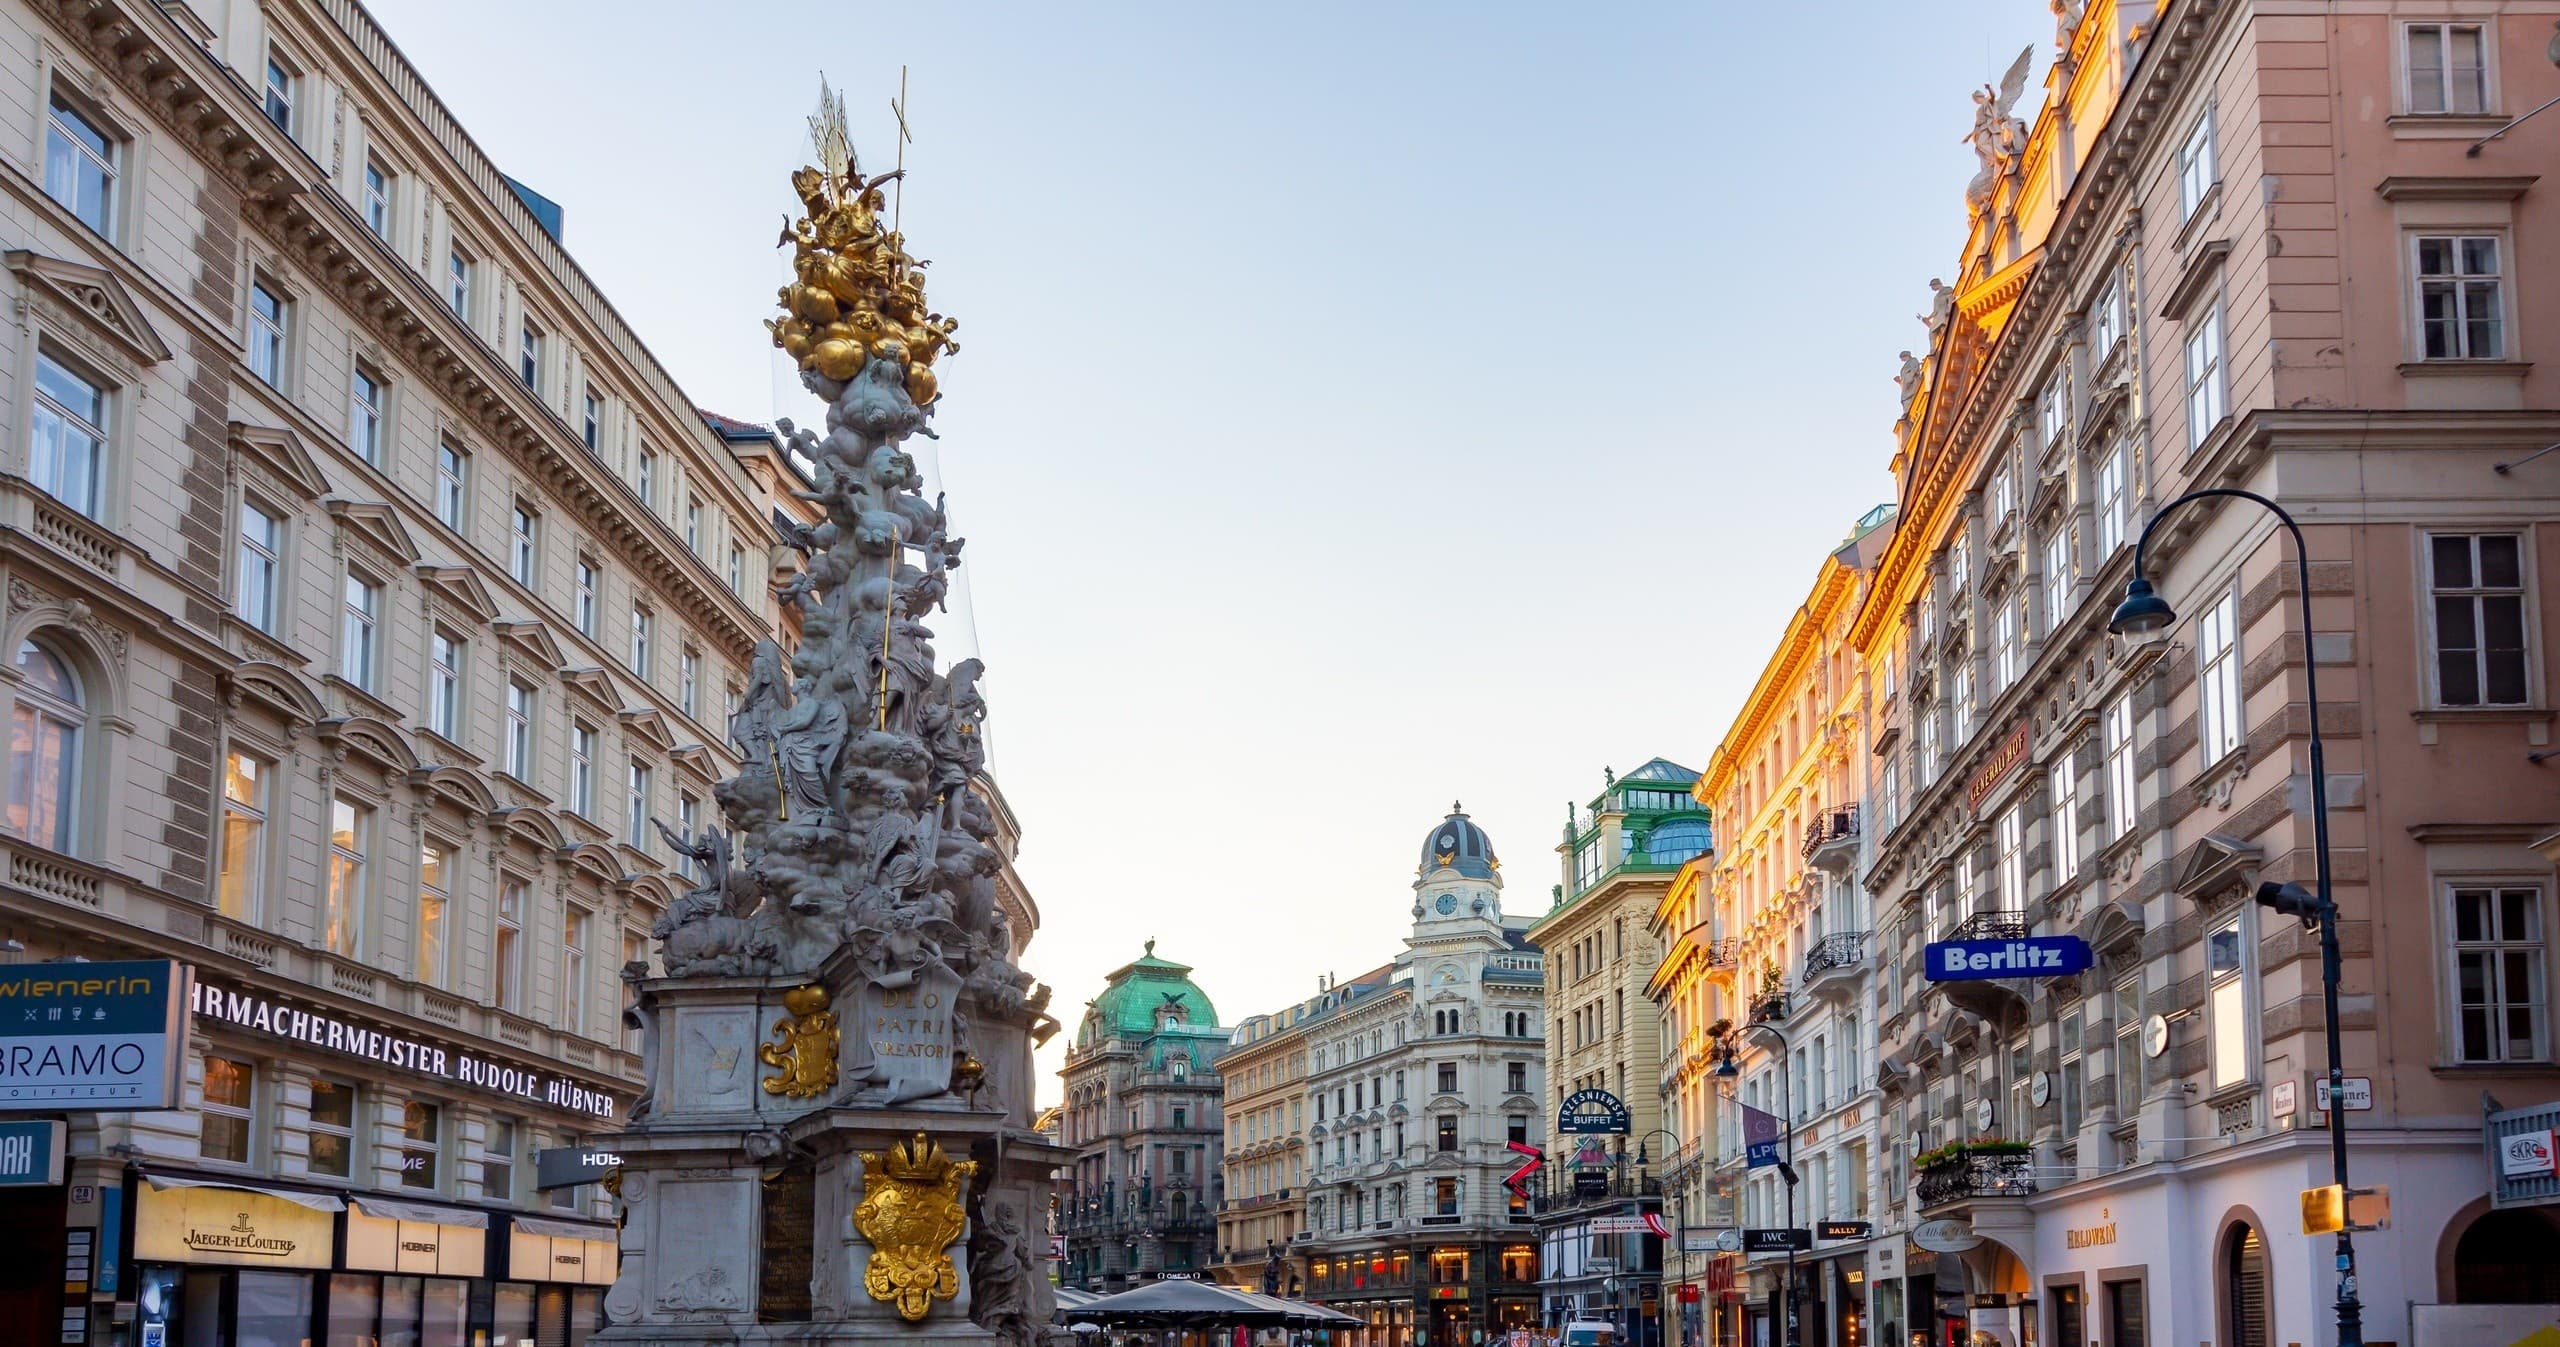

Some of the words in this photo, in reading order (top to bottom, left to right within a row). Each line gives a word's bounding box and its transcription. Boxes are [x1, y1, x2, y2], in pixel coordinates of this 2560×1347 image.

[1970, 749, 2006, 801] GENERALI
[2007, 731, 2025, 763] HOF
[1944, 942, 2063, 971] Berlitz
[0, 976, 151, 998] wienerin
[875, 1016, 944, 1034] PATRI
[0, 1043, 145, 1077] RAMO
[459, 1056, 537, 1097] RUDOLF
[547, 1078, 614, 1118] HÜBNER
[1573, 1116, 1612, 1124] BUFFET
[0, 1136, 32, 1175] AX
[402, 1241, 436, 1253] HÜBNER
[1762, 1232, 1786, 1242] IWC
[2067, 1222, 2116, 1249] HELDWEIN
